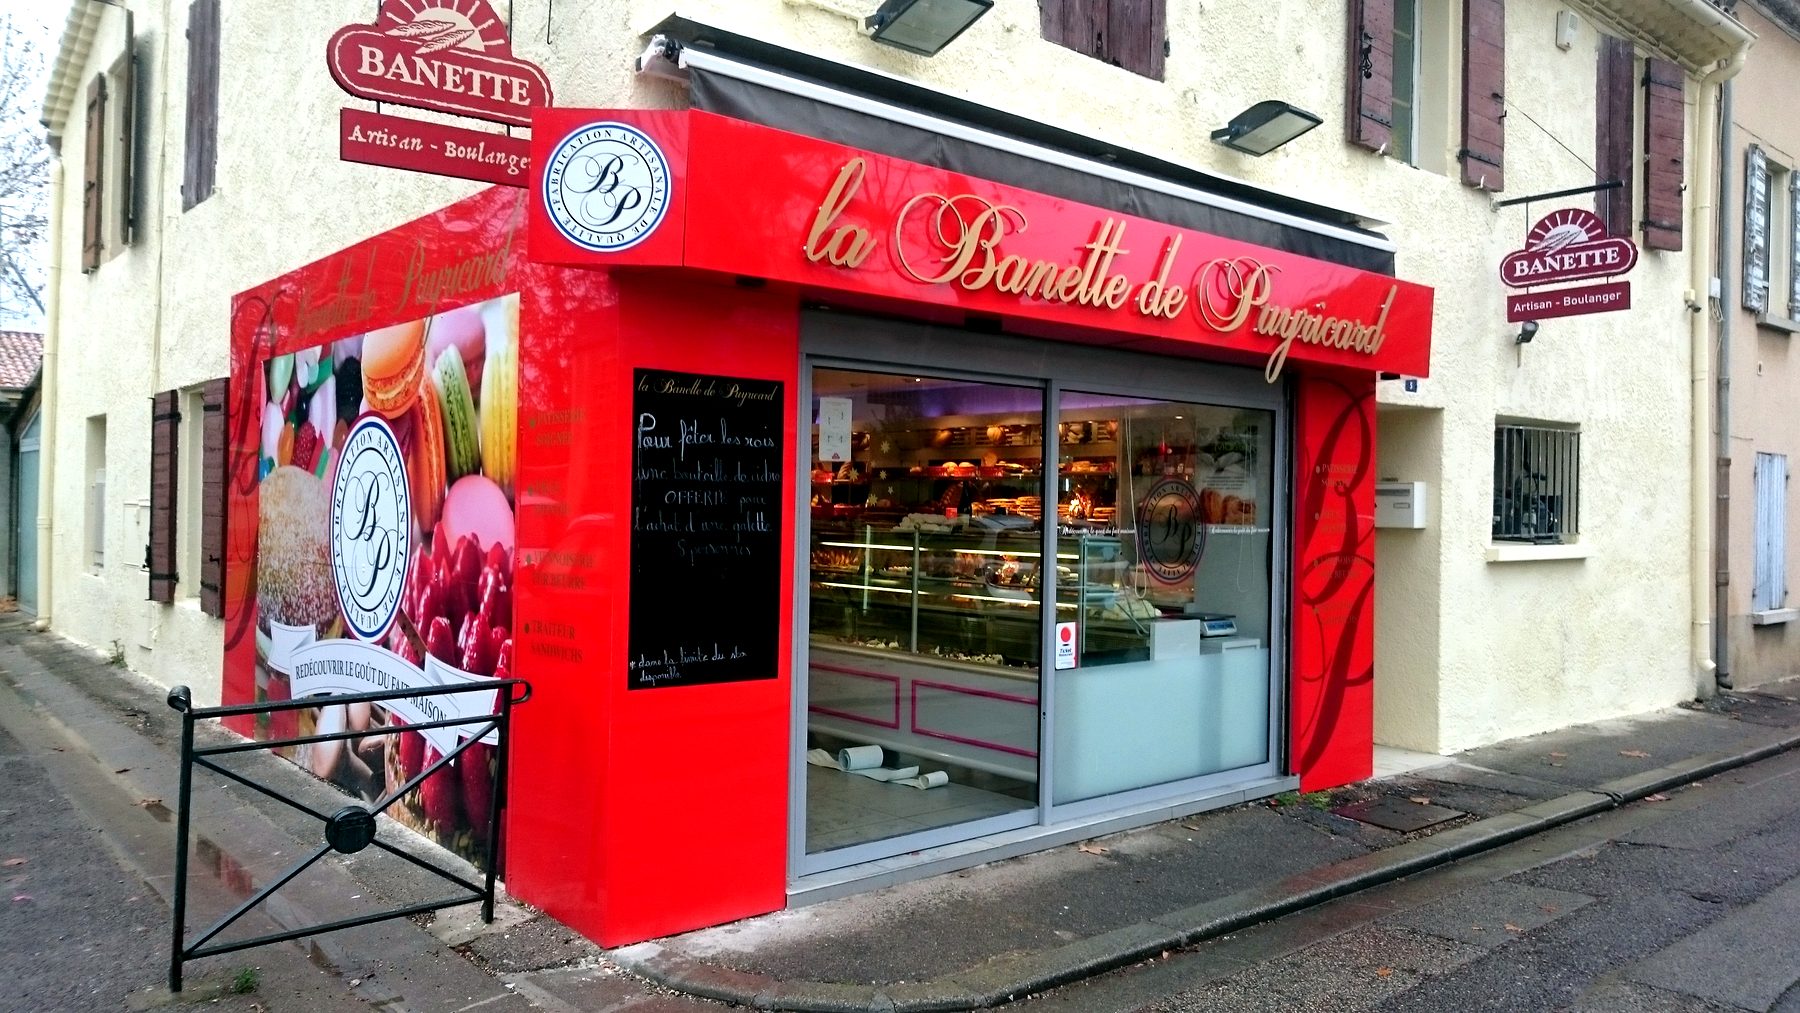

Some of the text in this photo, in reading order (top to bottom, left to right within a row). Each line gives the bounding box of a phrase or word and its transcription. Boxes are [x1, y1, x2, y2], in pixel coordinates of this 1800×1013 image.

[357, 44, 531, 106] BANETTE
[348, 124, 423, 151] Artisan
[551, 129, 664, 244] FABRICATION ARTISANALE DE QUALITE
[804, 158, 1398, 385] la Banette de Puyricard
[1513, 247, 1621, 278] BANETTE
[1513, 299, 1552, 313] Artisan
[1563, 291, 1622, 307] Boulanger
[637, 373, 649, 391] la
[703, 379, 716, 396] de
[638, 412, 674, 449] Pour
[720, 416, 741, 446] les
[744, 425, 775, 448] rois
[664, 490, 729, 506] OFFERTE
[295, 658, 345, 680] REDÉCOUVRIR
[344, 663, 354, 678] LE
[354, 661, 376, 684] GOÛT
[378, 671, 390, 690] DU
